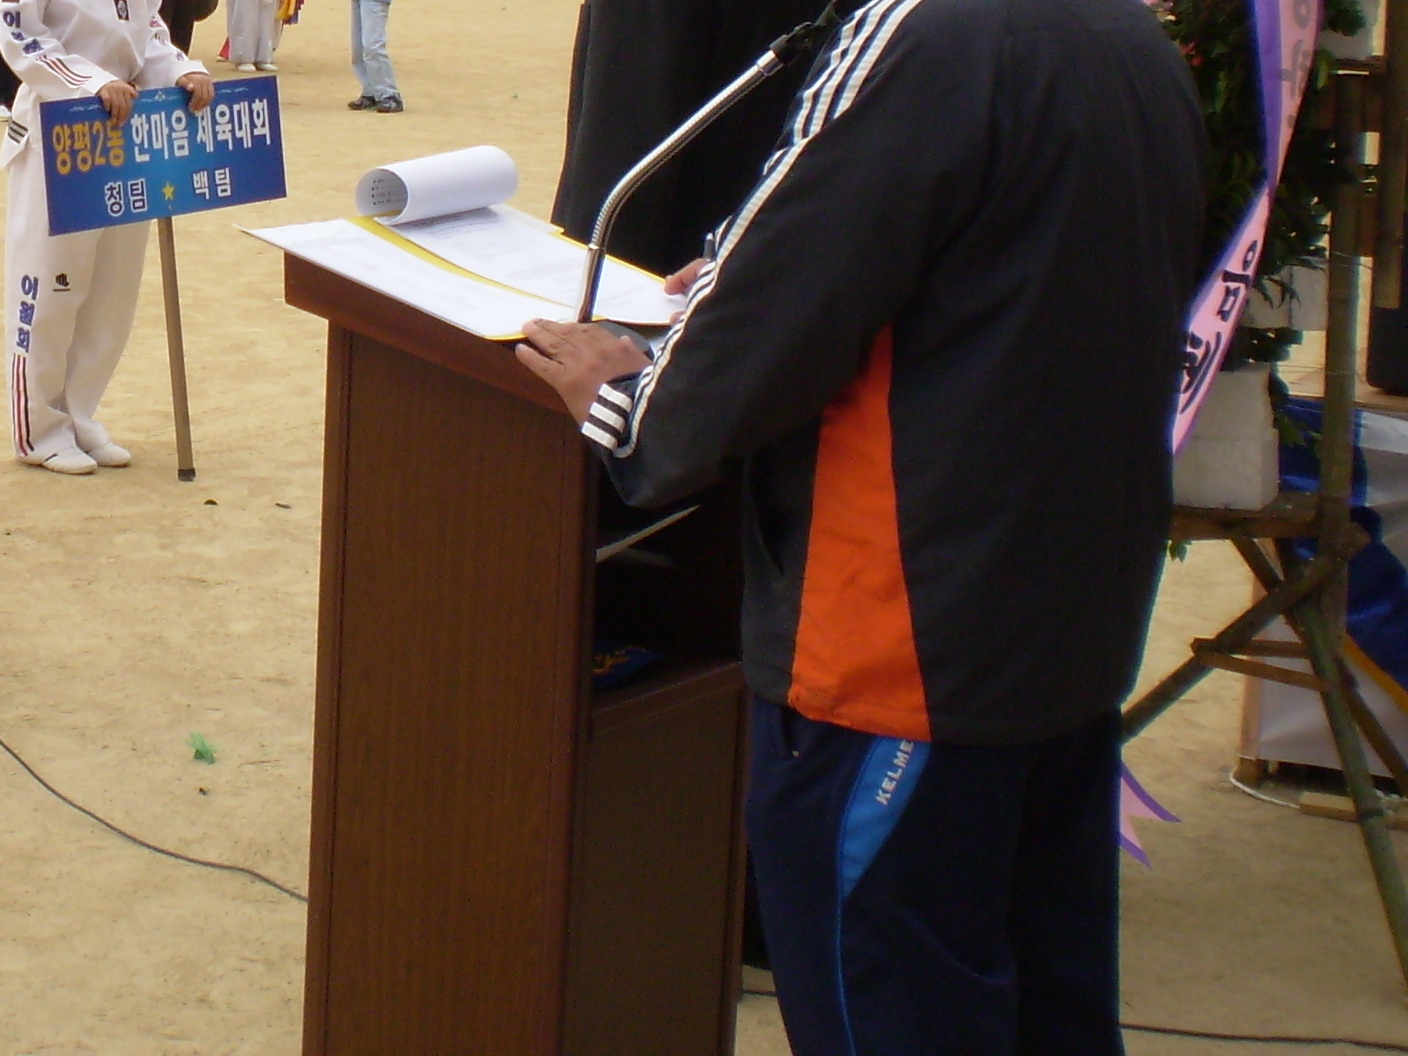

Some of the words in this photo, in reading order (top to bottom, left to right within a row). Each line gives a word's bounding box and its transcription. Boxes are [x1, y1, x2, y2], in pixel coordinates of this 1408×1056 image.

[52, 119, 126, 175] 양평2동
[130, 109, 190, 163] 한마음
[194, 98, 271, 153] 체육대회
[875, 739, 914, 806] KELME
